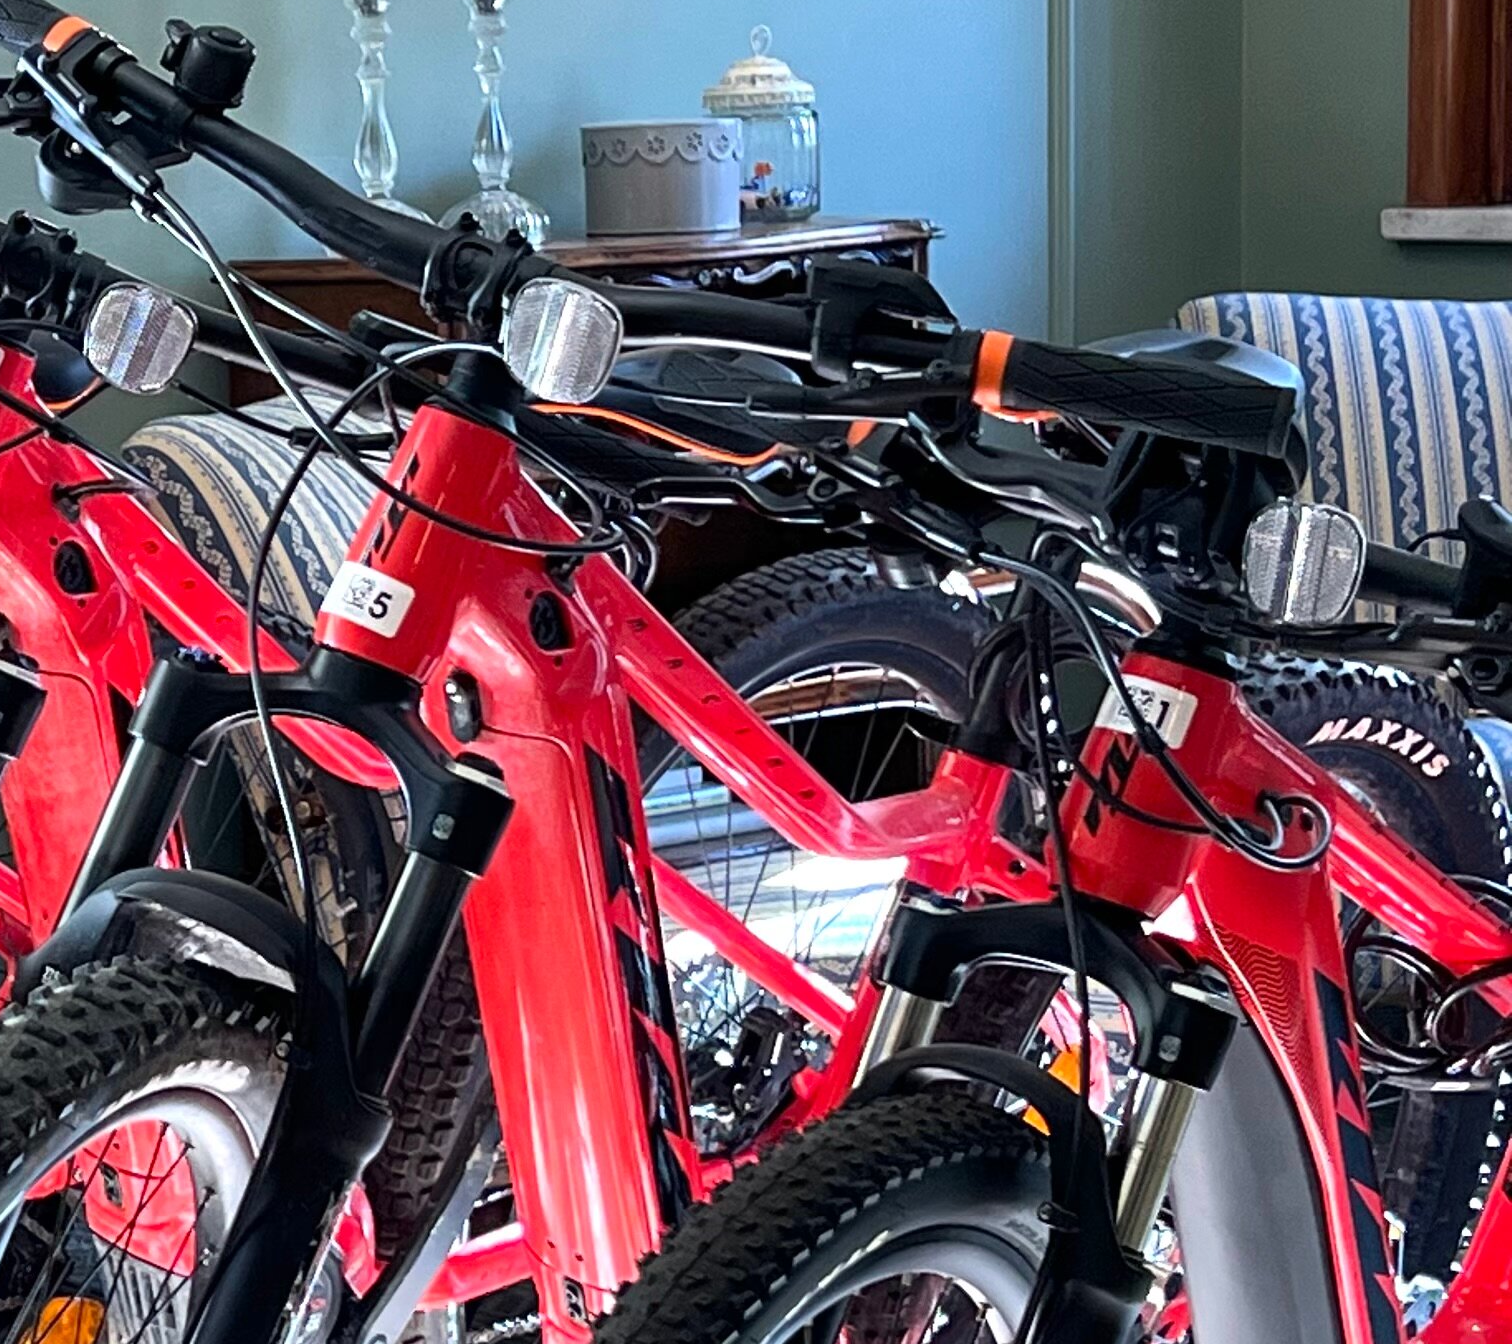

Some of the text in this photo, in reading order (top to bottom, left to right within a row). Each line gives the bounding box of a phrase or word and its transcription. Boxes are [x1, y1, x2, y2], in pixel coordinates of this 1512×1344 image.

[368, 591, 393, 620] 5
[1155, 700, 1171, 730] 1
[1305, 716, 1451, 778] MAXXIS
